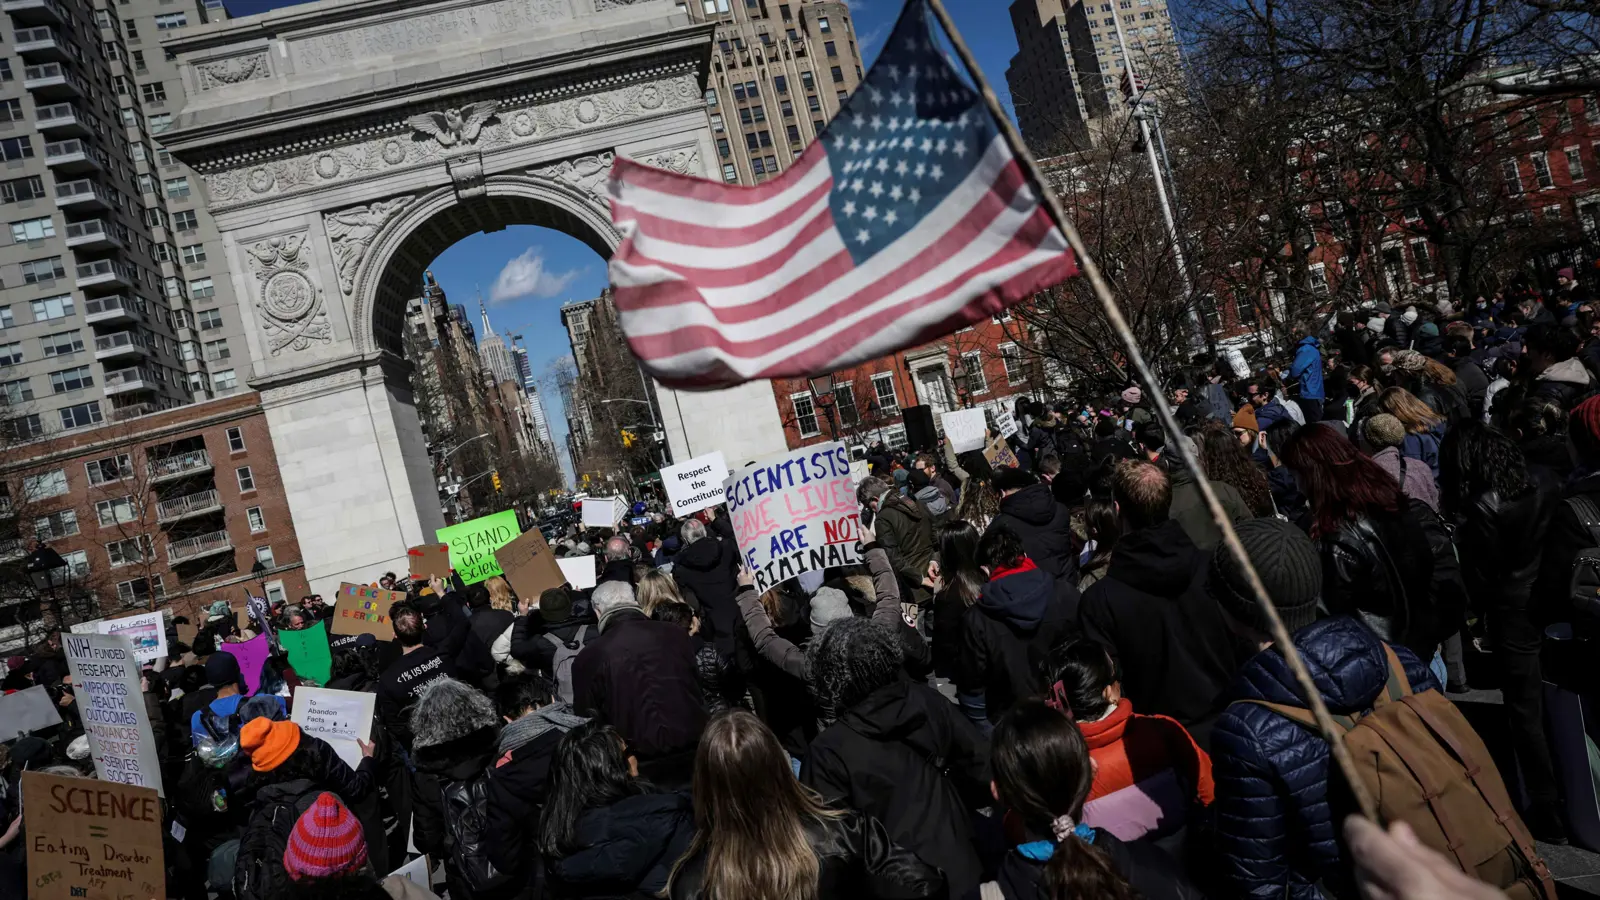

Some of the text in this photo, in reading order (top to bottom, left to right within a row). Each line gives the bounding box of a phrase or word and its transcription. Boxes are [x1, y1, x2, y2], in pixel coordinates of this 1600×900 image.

[438, 17, 478, 32] REPAIR
[397, 39, 414, 52] OF
[417, 33, 443, 46] GOD
[677, 465, 712, 481] Respect
[726, 446, 850, 512] SCIENTISTS
[691, 480, 706, 489] the
[676, 487, 723, 508] Constitutio
[733, 478, 857, 541] SAVE LIVES
[451, 525, 511, 555] STAND
[770, 524, 809, 558] ARE
[824, 514, 859, 543] NOT
[462, 552, 483, 568] UP
[755, 541, 865, 593] RIMINALS
[344, 586, 397, 601] SCIENCE IS
[357, 600, 378, 611] FOR
[110, 617, 157, 631] ALL GENES
[342, 609, 391, 625] EVERYONE
[67, 637, 126, 660] NIH FUNDED
[77, 663, 127, 678] RESEARCH
[410, 666, 422, 677] US
[420, 656, 443, 673] Budget
[83, 681, 128, 696] IMPROVES
[90, 696, 126, 710] HEALTH
[86, 708, 137, 725] OUTCOMES
[308, 708, 337, 716] Abandon
[93, 725, 140, 741] ADVANCES
[98, 739, 137, 755] SCIENCE
[104, 755, 140, 772] SERVES
[107, 769, 144, 785] SOCIETY
[49, 784, 155, 822] SCIENCE
[35, 835, 152, 865] Eating Disorder
[69, 860, 135, 881] Treatment
[70, 886, 88, 897] DBT
